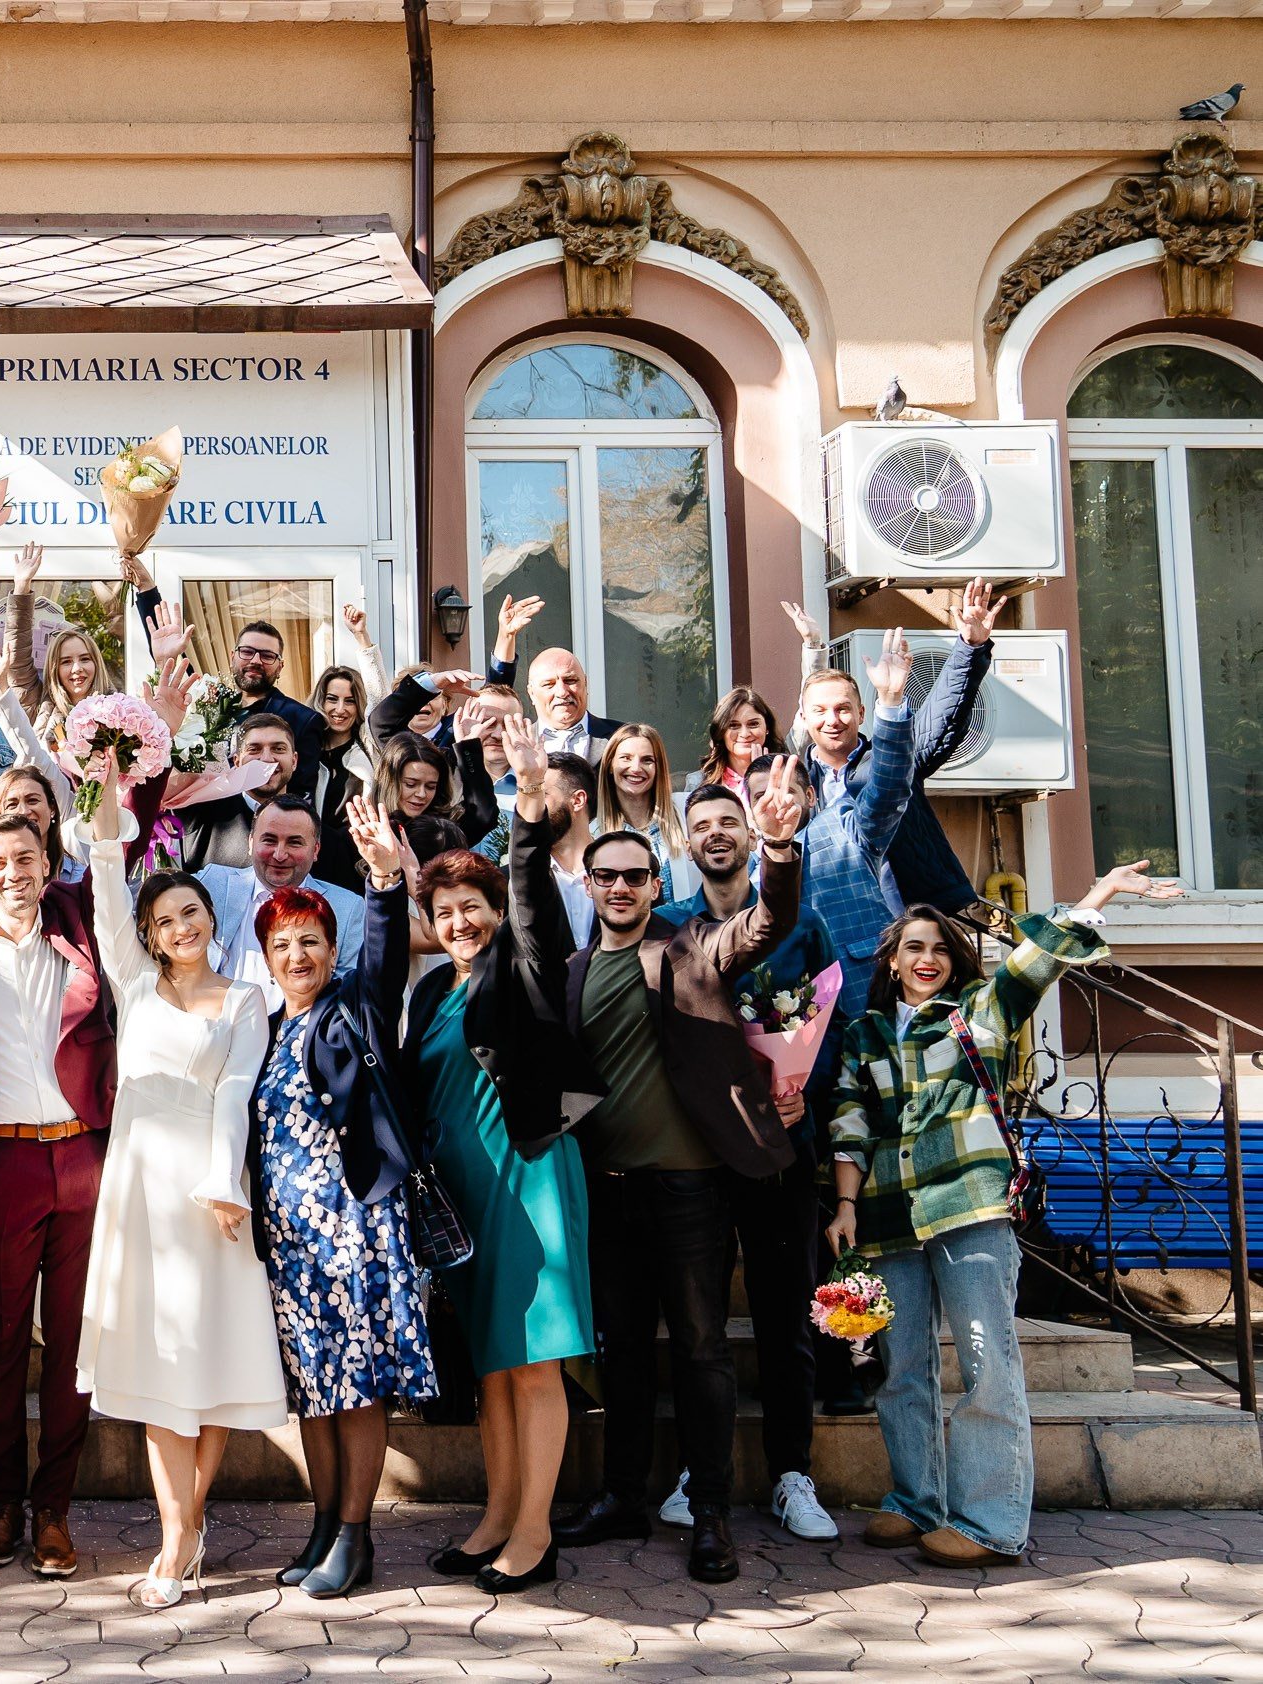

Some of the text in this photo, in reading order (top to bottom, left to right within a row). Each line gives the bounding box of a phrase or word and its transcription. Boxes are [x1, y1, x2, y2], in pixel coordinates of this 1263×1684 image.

[173, 356, 306, 381] SECTOR
[314, 358, 330, 381] 4
[19, 436, 48, 456] DE
[52, 436, 154, 456] EVIDENT
[182, 436, 330, 456] PERSOANELOR
[161, 500, 217, 525] ARE
[224, 500, 328, 525] CIVILA
